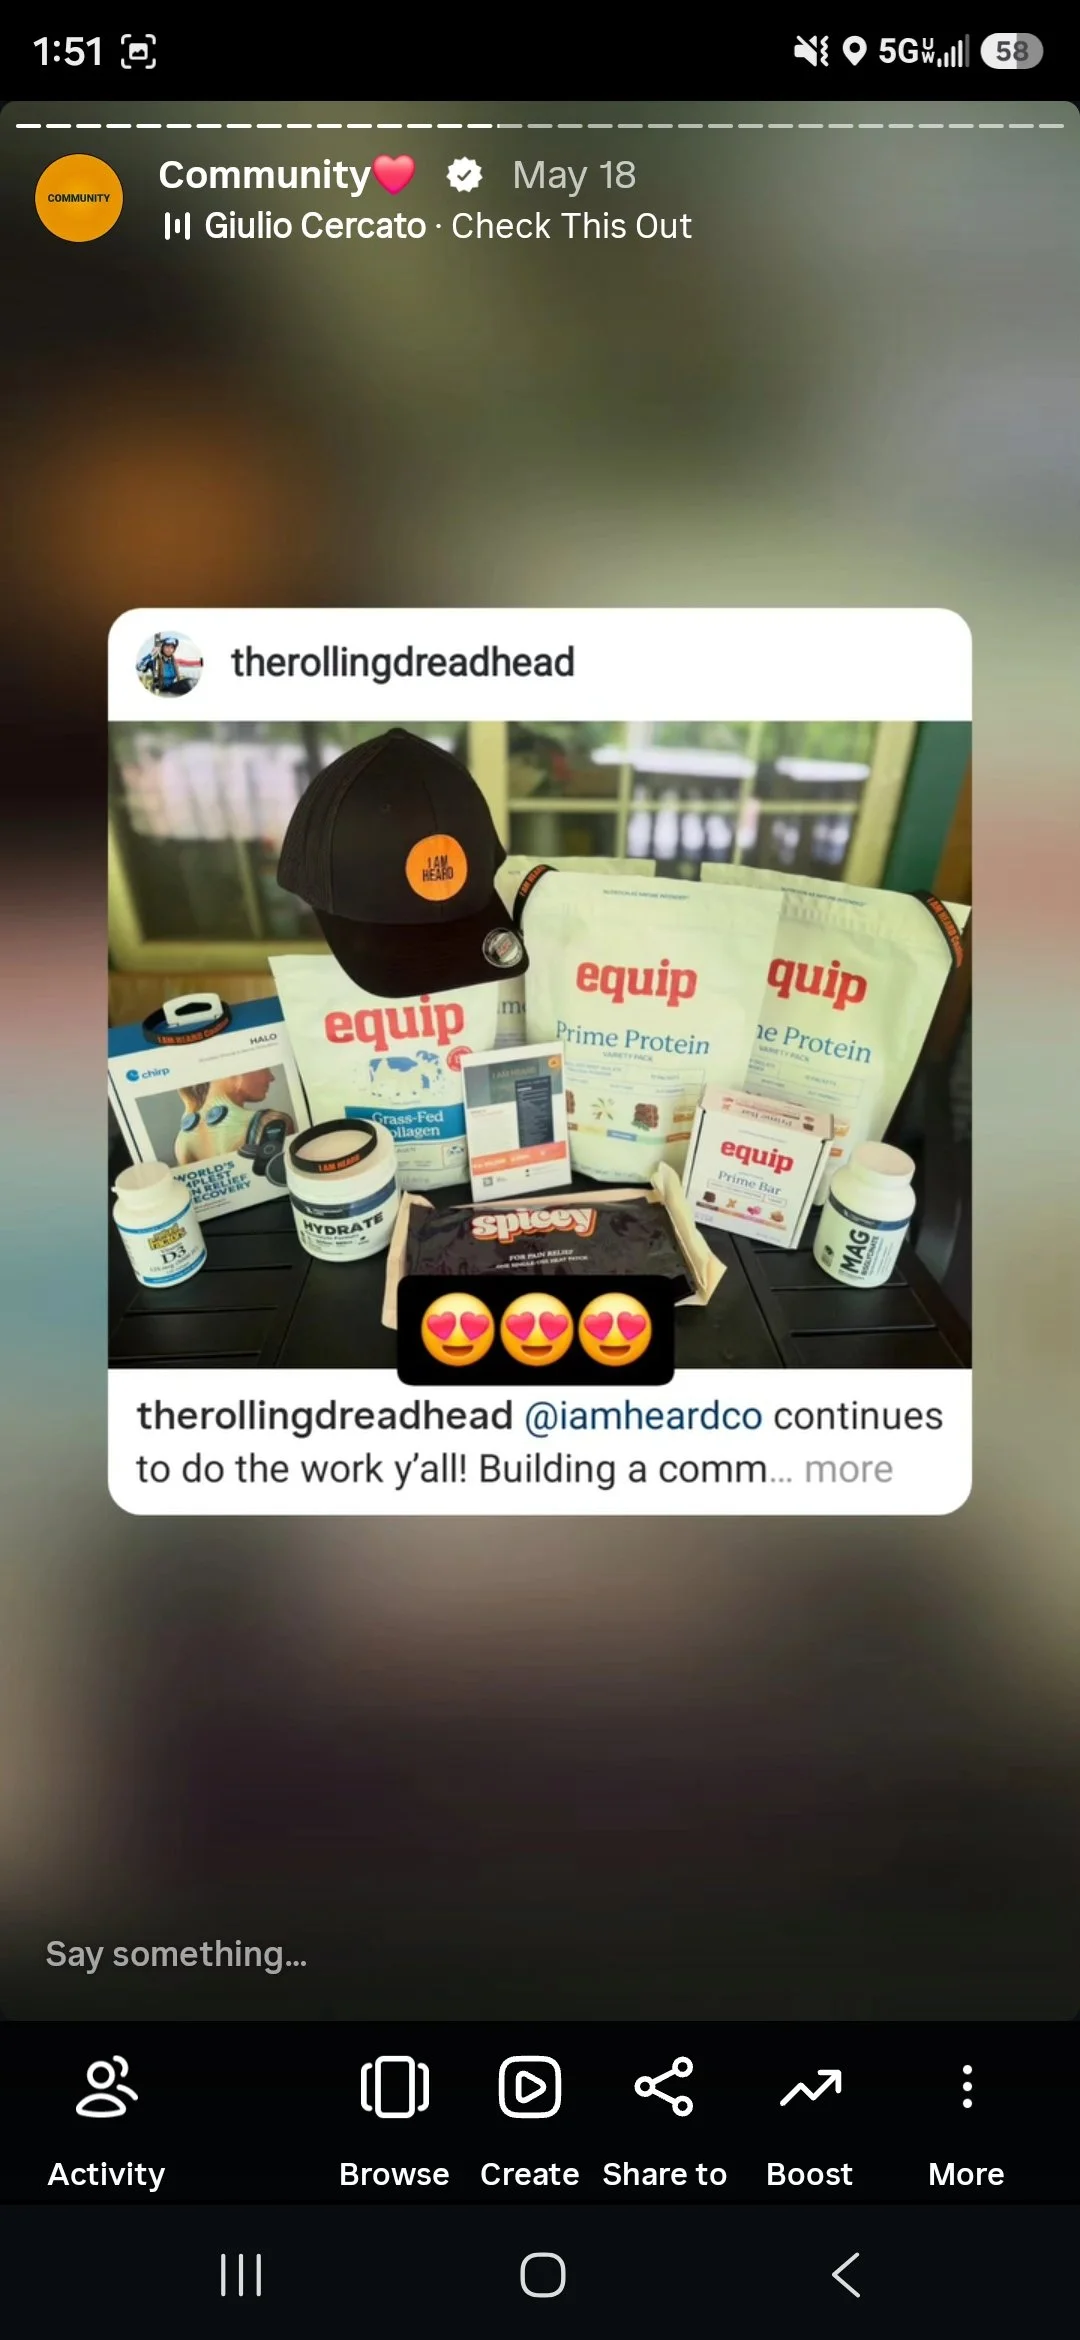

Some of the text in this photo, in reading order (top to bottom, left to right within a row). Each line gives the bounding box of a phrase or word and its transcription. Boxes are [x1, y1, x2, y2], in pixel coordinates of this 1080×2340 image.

[422, 866, 454, 882] HEARD
[433, 855, 448, 868] AM
[576, 958, 698, 1007] equip
[767, 957, 868, 1011] quip
[324, 993, 465, 1052] equip
[249, 1032, 279, 1045] HALO
[556, 1019, 711, 1055] Prime Protein
[783, 1026, 872, 1063] Protein
[141, 1066, 171, 1080] chirp
[371, 1109, 444, 1124] Grass-Fed
[391, 1125, 441, 1140] ollagen
[720, 1141, 795, 1175] equip
[193, 1181, 252, 1204] ECOVERY
[717, 1169, 757, 1189] Prime
[759, 1182, 783, 1196] Bar
[302, 1211, 384, 1236] HYDRATE
[471, 1207, 598, 1245] spicey
[161, 1245, 187, 1264] D3
[840, 1229, 871, 1274] MAG
